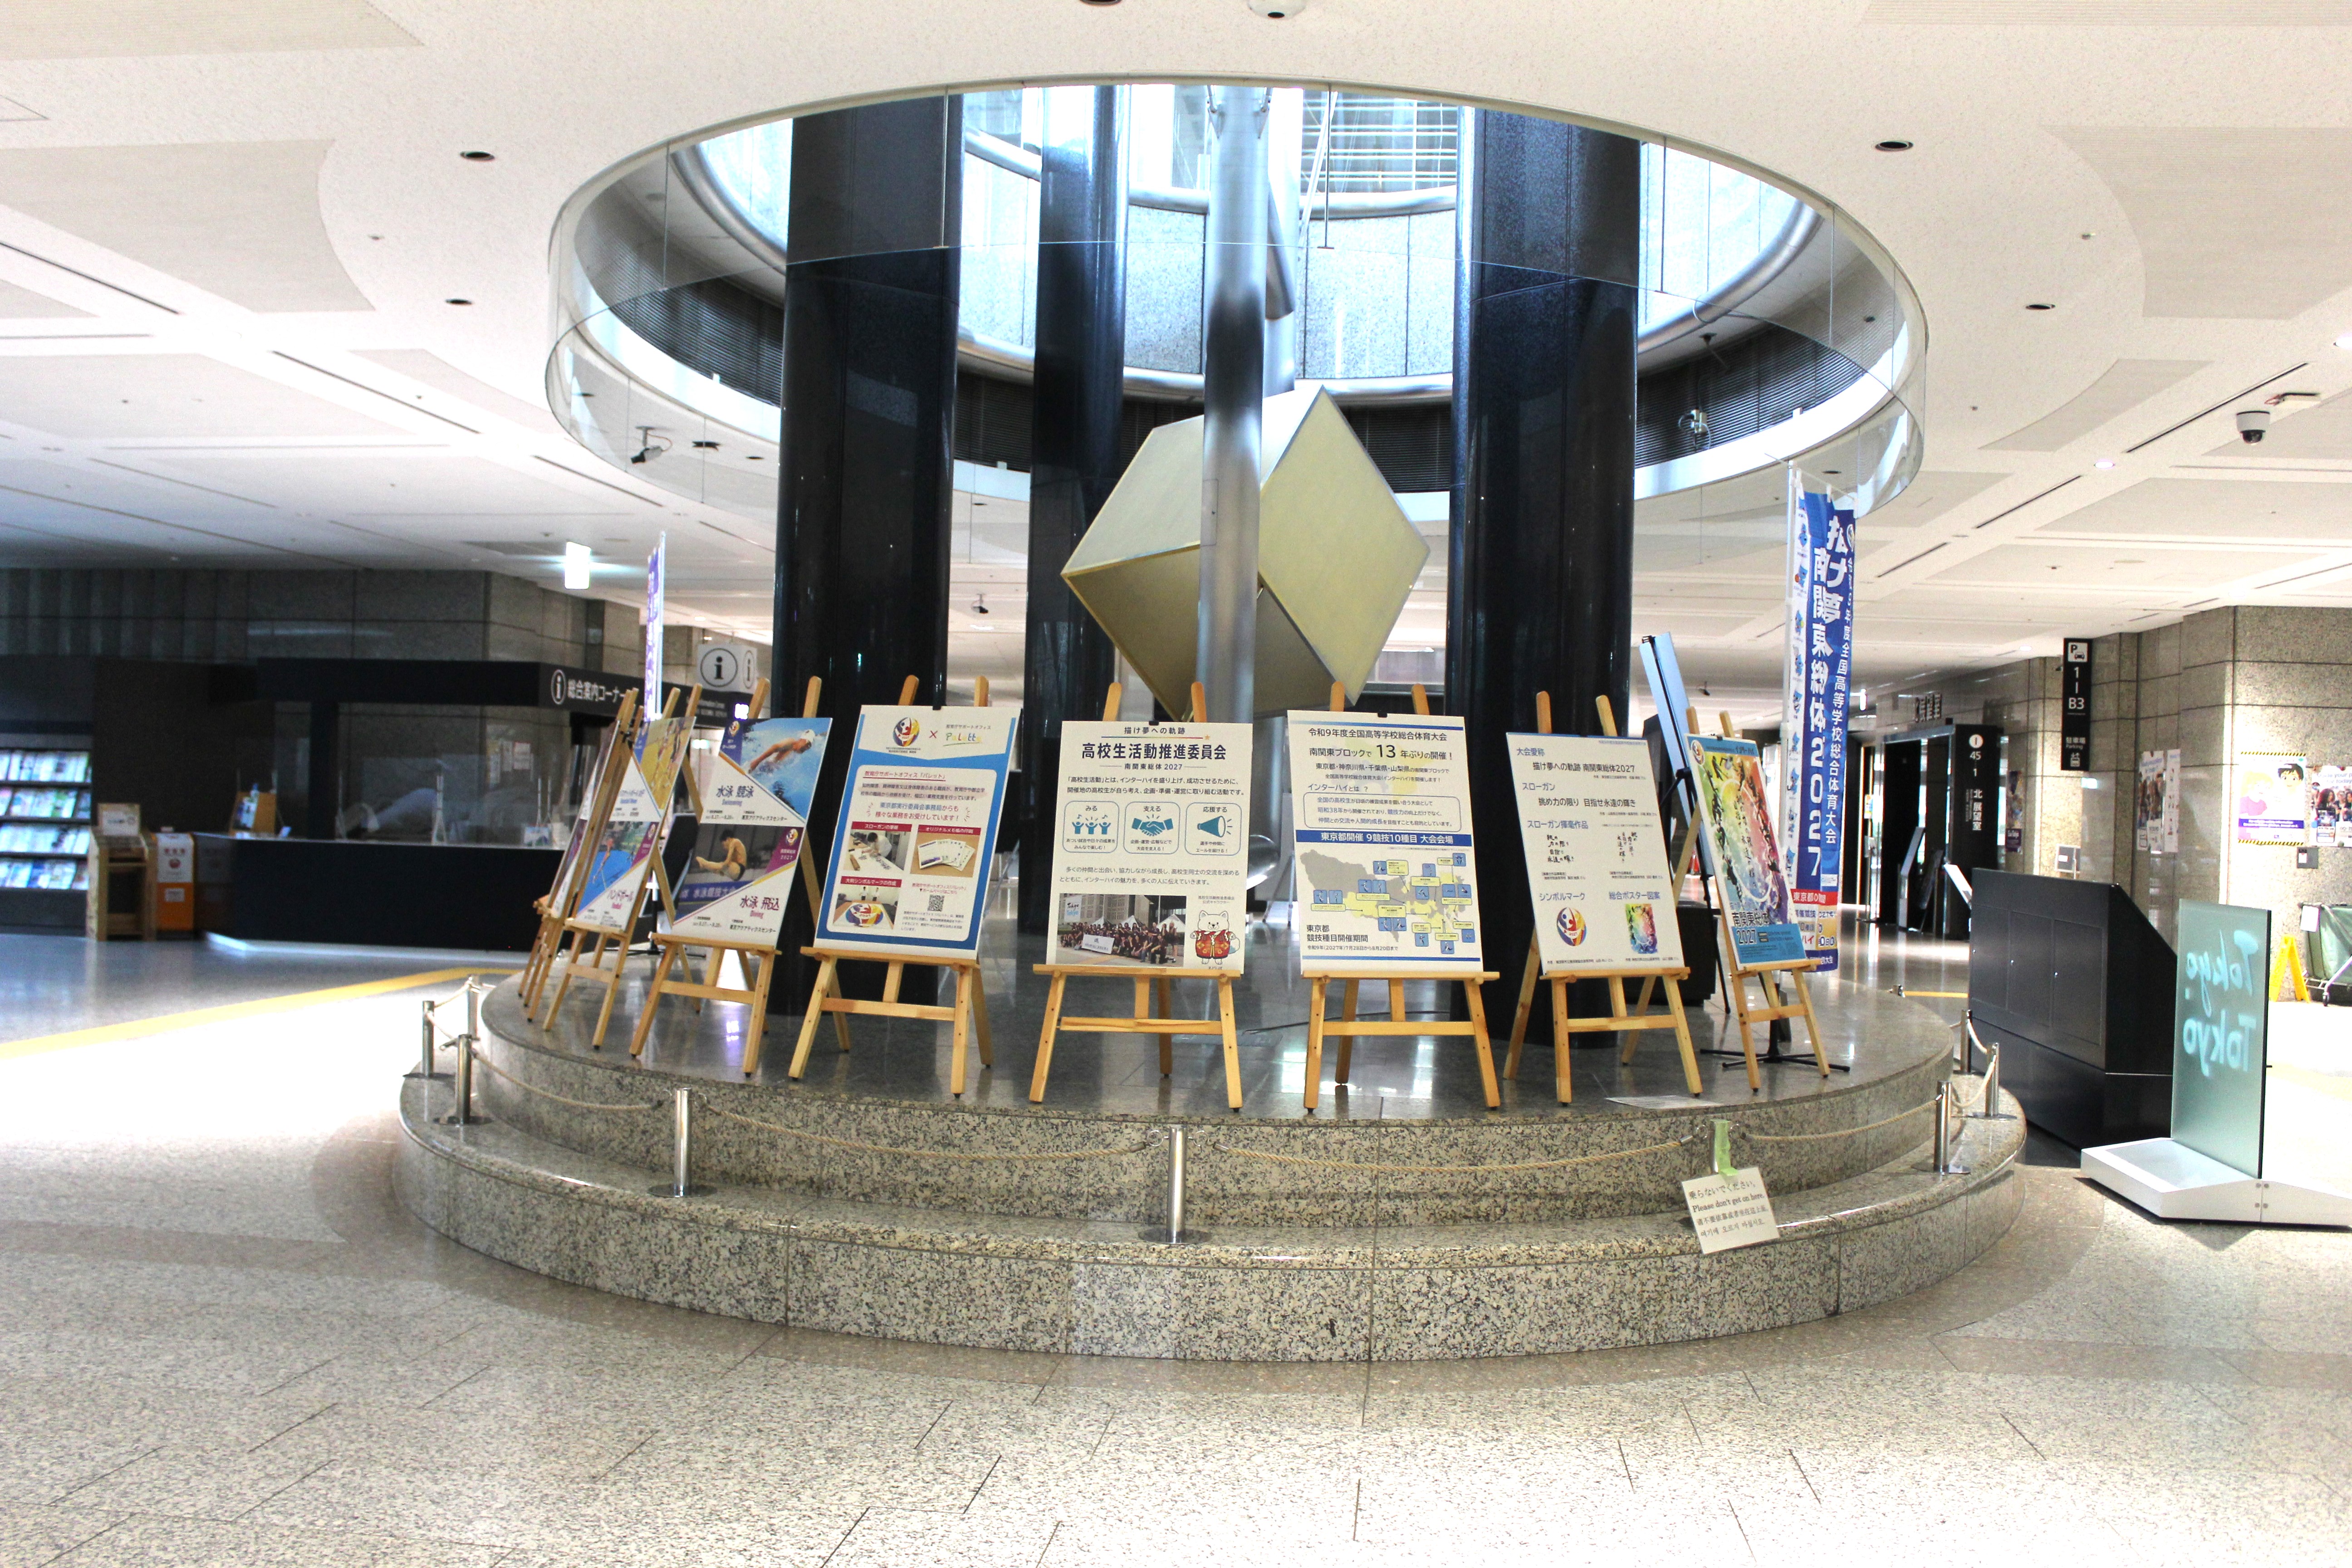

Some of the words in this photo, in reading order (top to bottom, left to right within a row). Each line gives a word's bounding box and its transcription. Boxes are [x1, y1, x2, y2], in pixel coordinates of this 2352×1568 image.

[2069, 697, 2084, 709] B3
[1308, 728, 1447, 742] 令和9年度全国高等学校総合体育大会
[1082, 743, 1226, 760] 高校生活動推進委員会
[1309, 748, 1372, 758] 南関東ブロックで
[1376, 745, 1396, 759] 13
[1400, 750, 1452, 760] 年ぶりの開催！
[1516, 747, 1545, 756] 大会愛称
[1970, 752, 1981, 760] 45
[1533, 762, 1581, 771] 描け夢への軌跡
[1583, 764, 1635, 773] 南関東総体2027
[1067, 776, 1240, 785] 「高校生活動」とは、インターハイを盛り上げ、成功させるために、
[716, 785, 733, 798] 水泳
[735, 785, 755, 798] 競泳
[1067, 787, 1245, 796] 開催地の高校生が自ら考え、企画・準備・運営に取り組む活動です。
[1522, 782, 1555, 791] スローガン
[1538, 797, 1579, 807] 挑め力の限り
[1584, 799, 1636, 808] 目指せ永遠の輝き
[1321, 832, 1364, 842] 東京都開催
[1367, 833, 1417, 843] 9競技10種目
[1420, 835, 1454, 844] 大会会場
[1539, 892, 1585, 901] シンボルマーク
[1608, 891, 1661, 900] 総合ポスター図案
[740, 896, 759, 909] 水泳
[761, 897, 779, 911] 飛込
[1306, 924, 1329, 933] 東京都
[1307, 934, 1368, 943] 競技種目開催期間
[1736, 929, 1757, 945] 2027
[1688, 1181, 1756, 1200] 乗らないでください。
[1692, 1203, 1714, 1212] Please
[1715, 1199, 1731, 1208] don't
[1732, 1197, 1741, 1205] get
